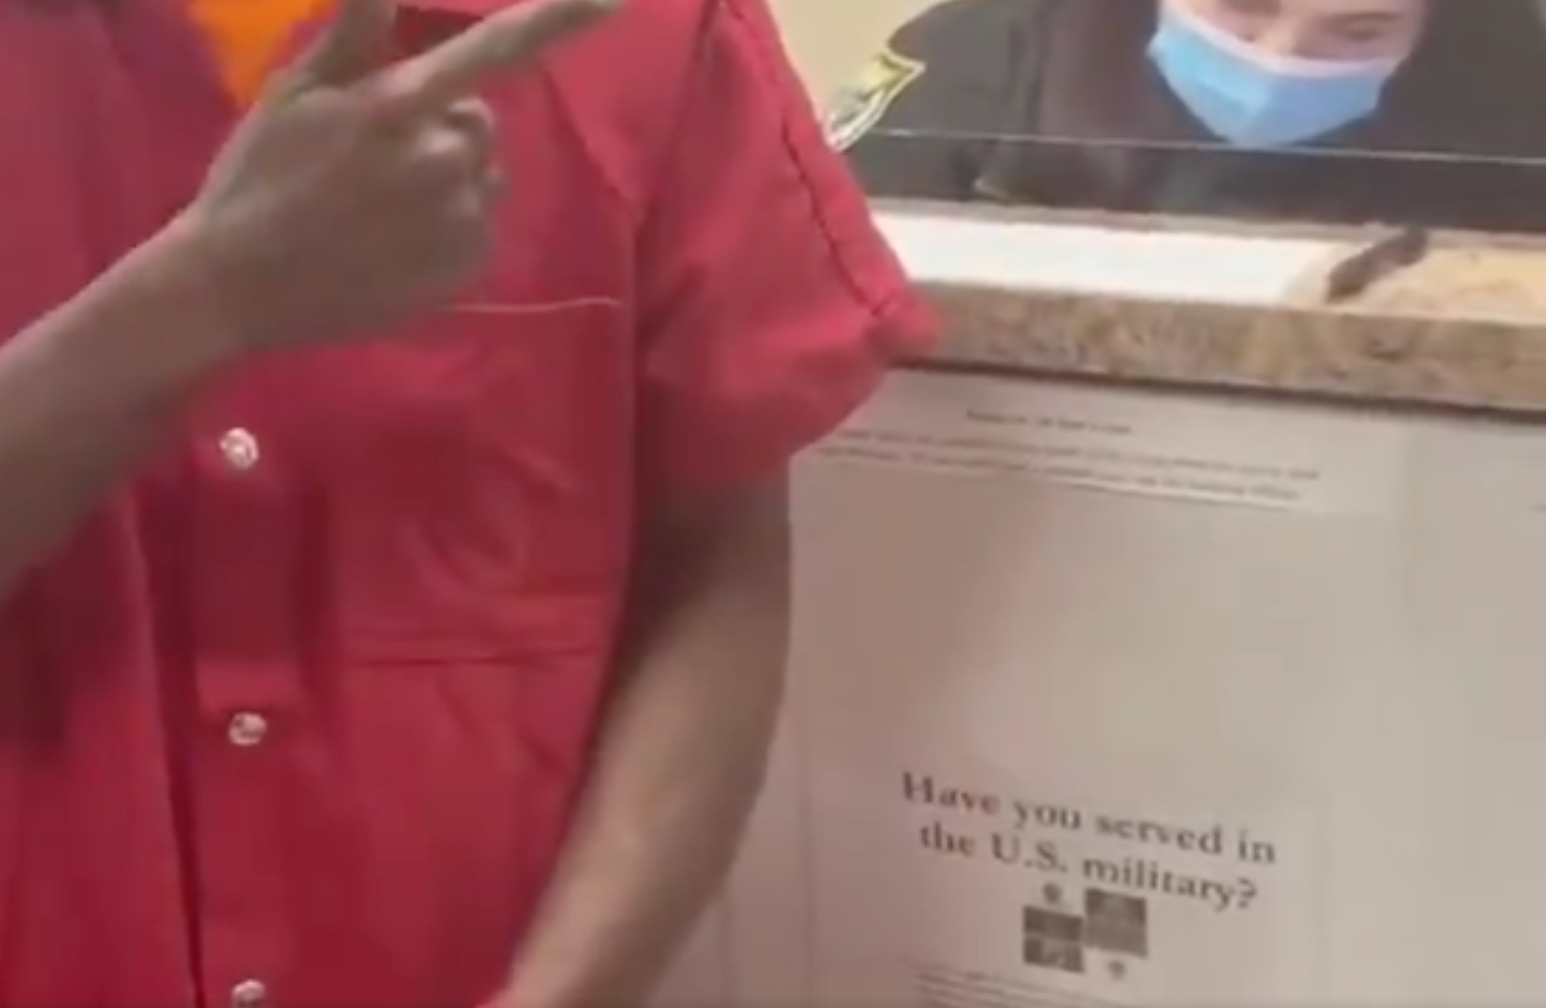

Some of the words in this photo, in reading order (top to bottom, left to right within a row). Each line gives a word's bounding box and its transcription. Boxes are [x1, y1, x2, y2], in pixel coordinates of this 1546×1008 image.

[901, 770, 1001, 816] Have
[1013, 798, 1082, 831] you
[1094, 812, 1224, 855] served
[1237, 829, 1277, 864] in
[918, 821, 976, 858] the
[990, 833, 1069, 875] U.S.
[1082, 854, 1260, 914] military?
